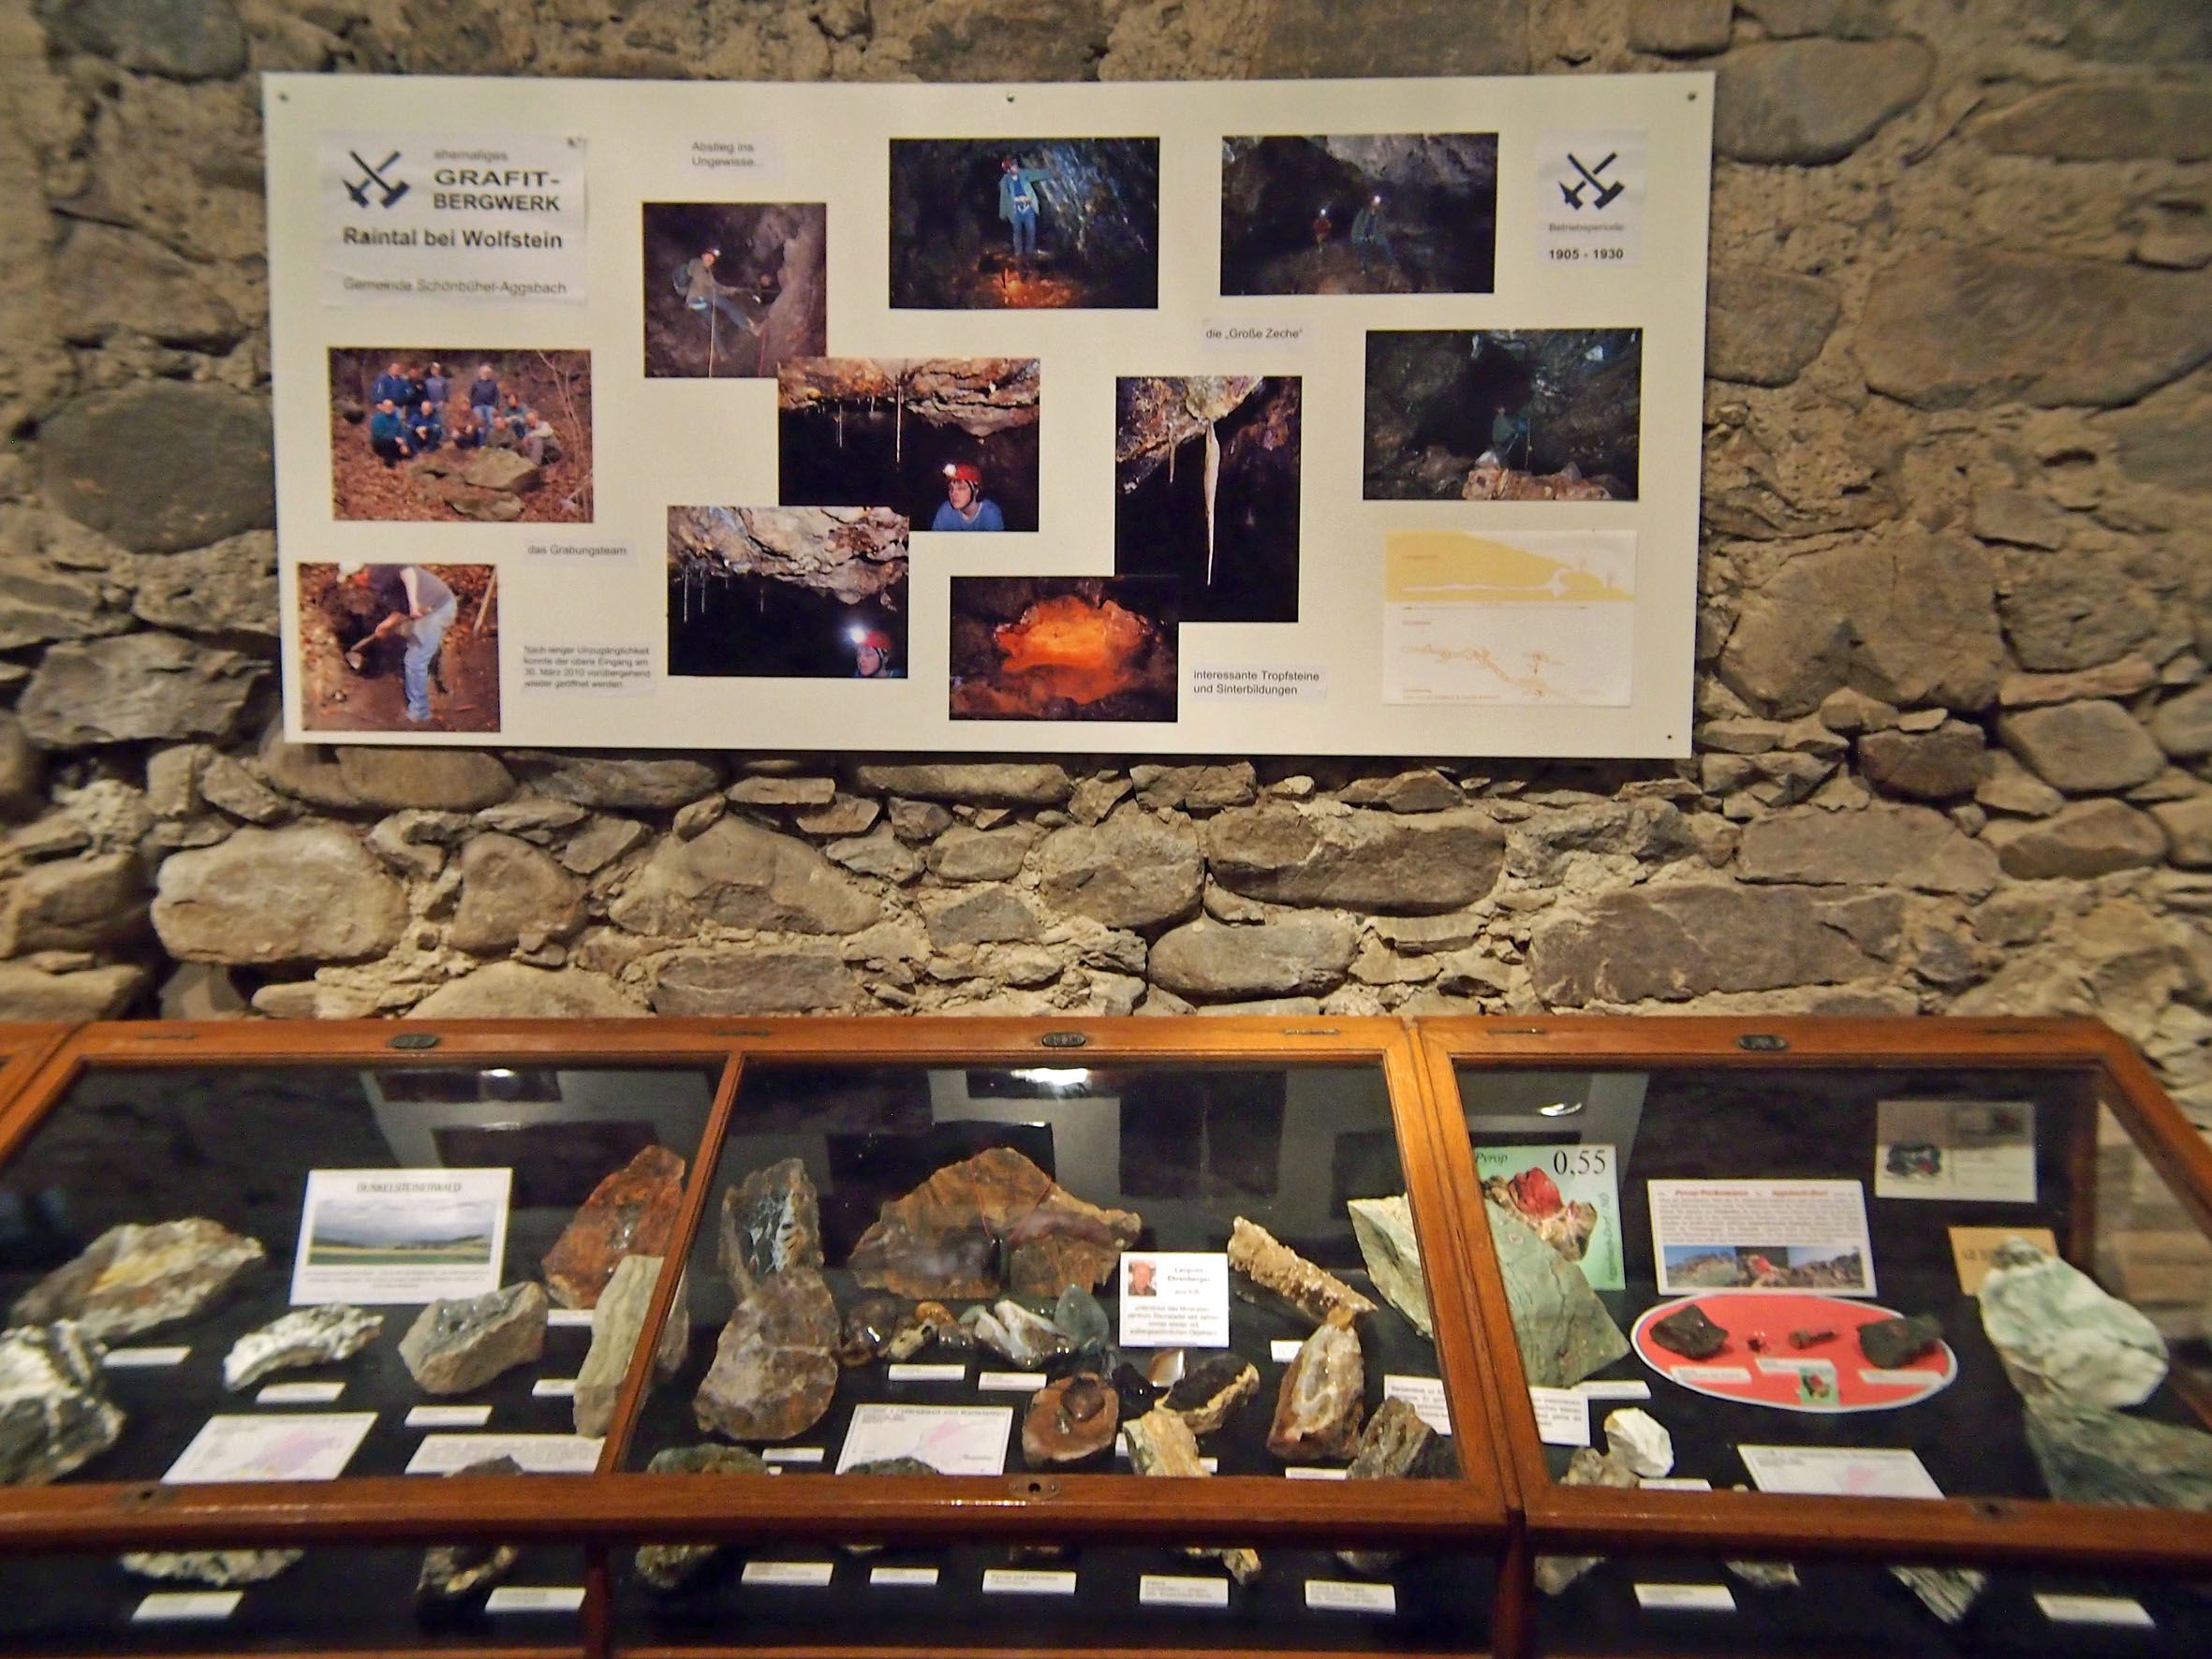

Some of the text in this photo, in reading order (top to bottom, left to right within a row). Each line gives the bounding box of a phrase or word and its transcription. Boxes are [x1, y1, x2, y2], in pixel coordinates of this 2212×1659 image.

[434, 149, 509, 162] ehemaliges
[434, 169, 560, 187] GRAFIT-
[433, 193, 560, 212] BERGWERK
[343, 227, 563, 249] Raintal bei Wolfstein
[1549, 248, 1580, 260] 1905
[1593, 249, 1625, 260] 1930
[343, 277, 412, 292] Gemeinde
[1206, 329, 1222, 339] die
[527, 544, 627, 558] das Grabungsteam
[1261, 669, 1320, 683] Tropfsteine
[1193, 683, 1298, 697] und Sinterbildungen
[1554, 1149, 1606, 1177] 0,55
